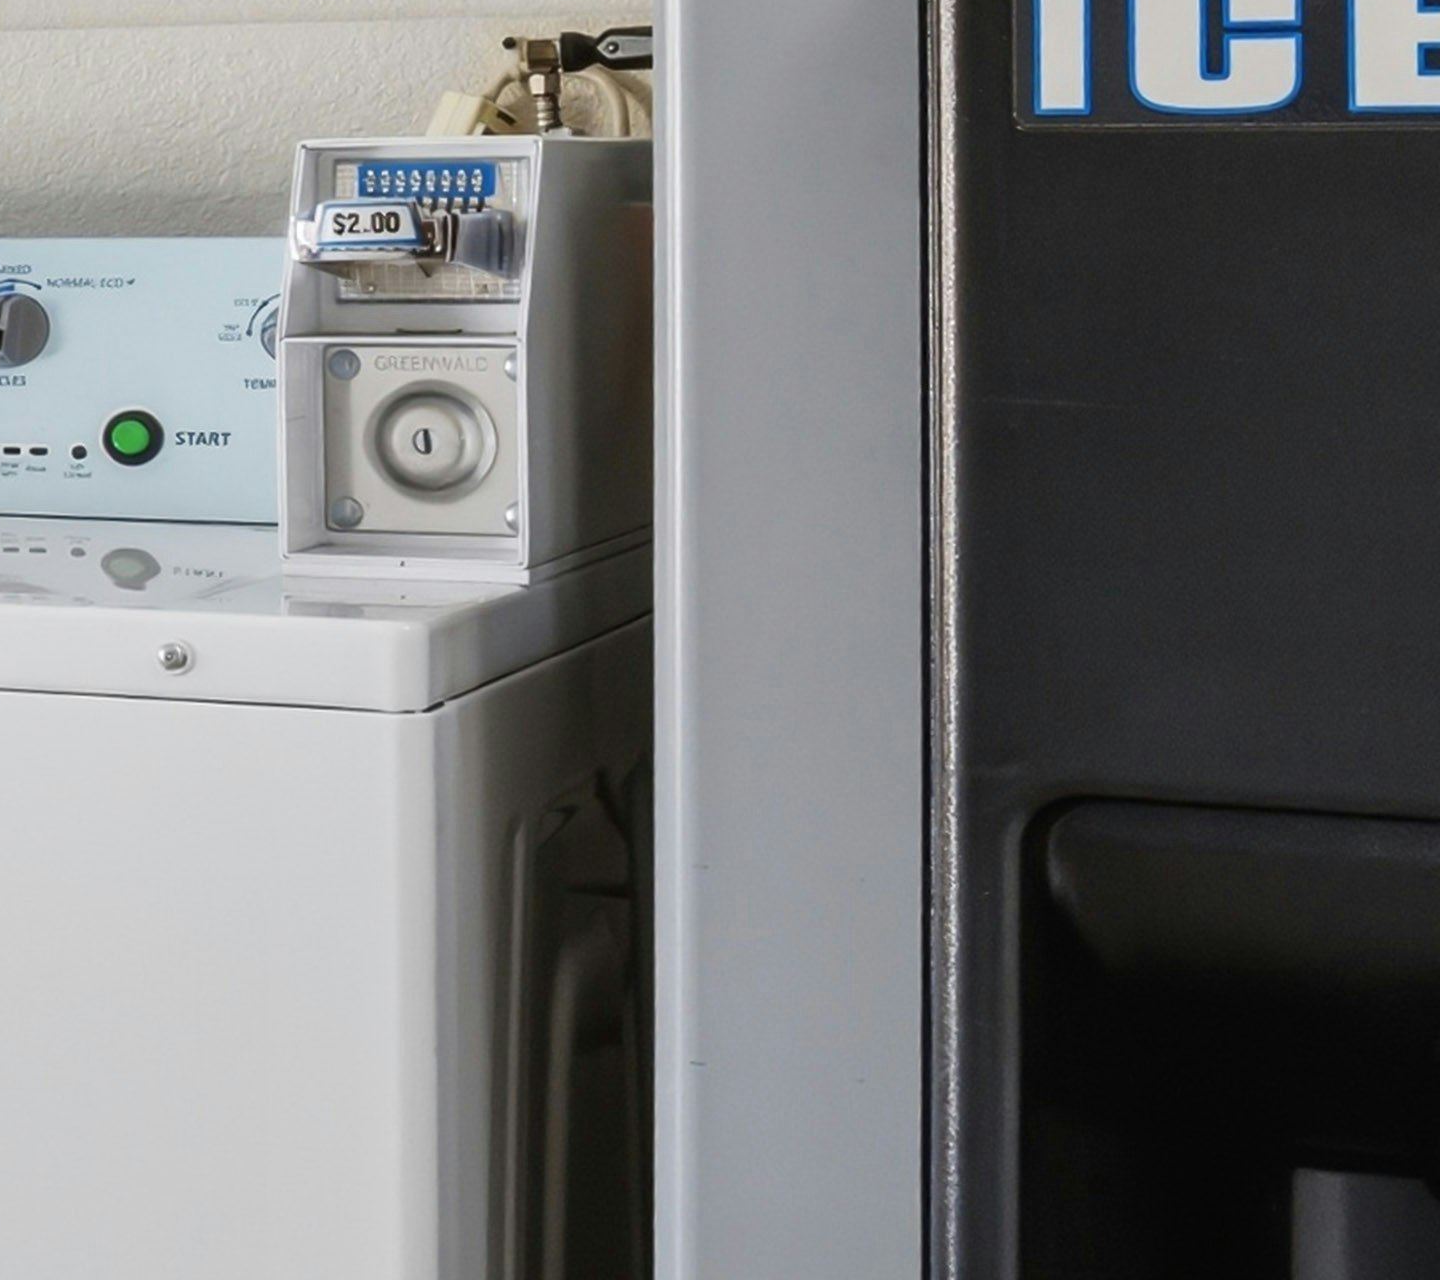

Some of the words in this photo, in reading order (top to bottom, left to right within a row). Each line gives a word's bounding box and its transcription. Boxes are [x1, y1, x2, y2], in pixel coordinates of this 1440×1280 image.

[332, 211, 401, 235] $2.00
[374, 355, 488, 372] GREENWALD
[174, 430, 232, 447] START
